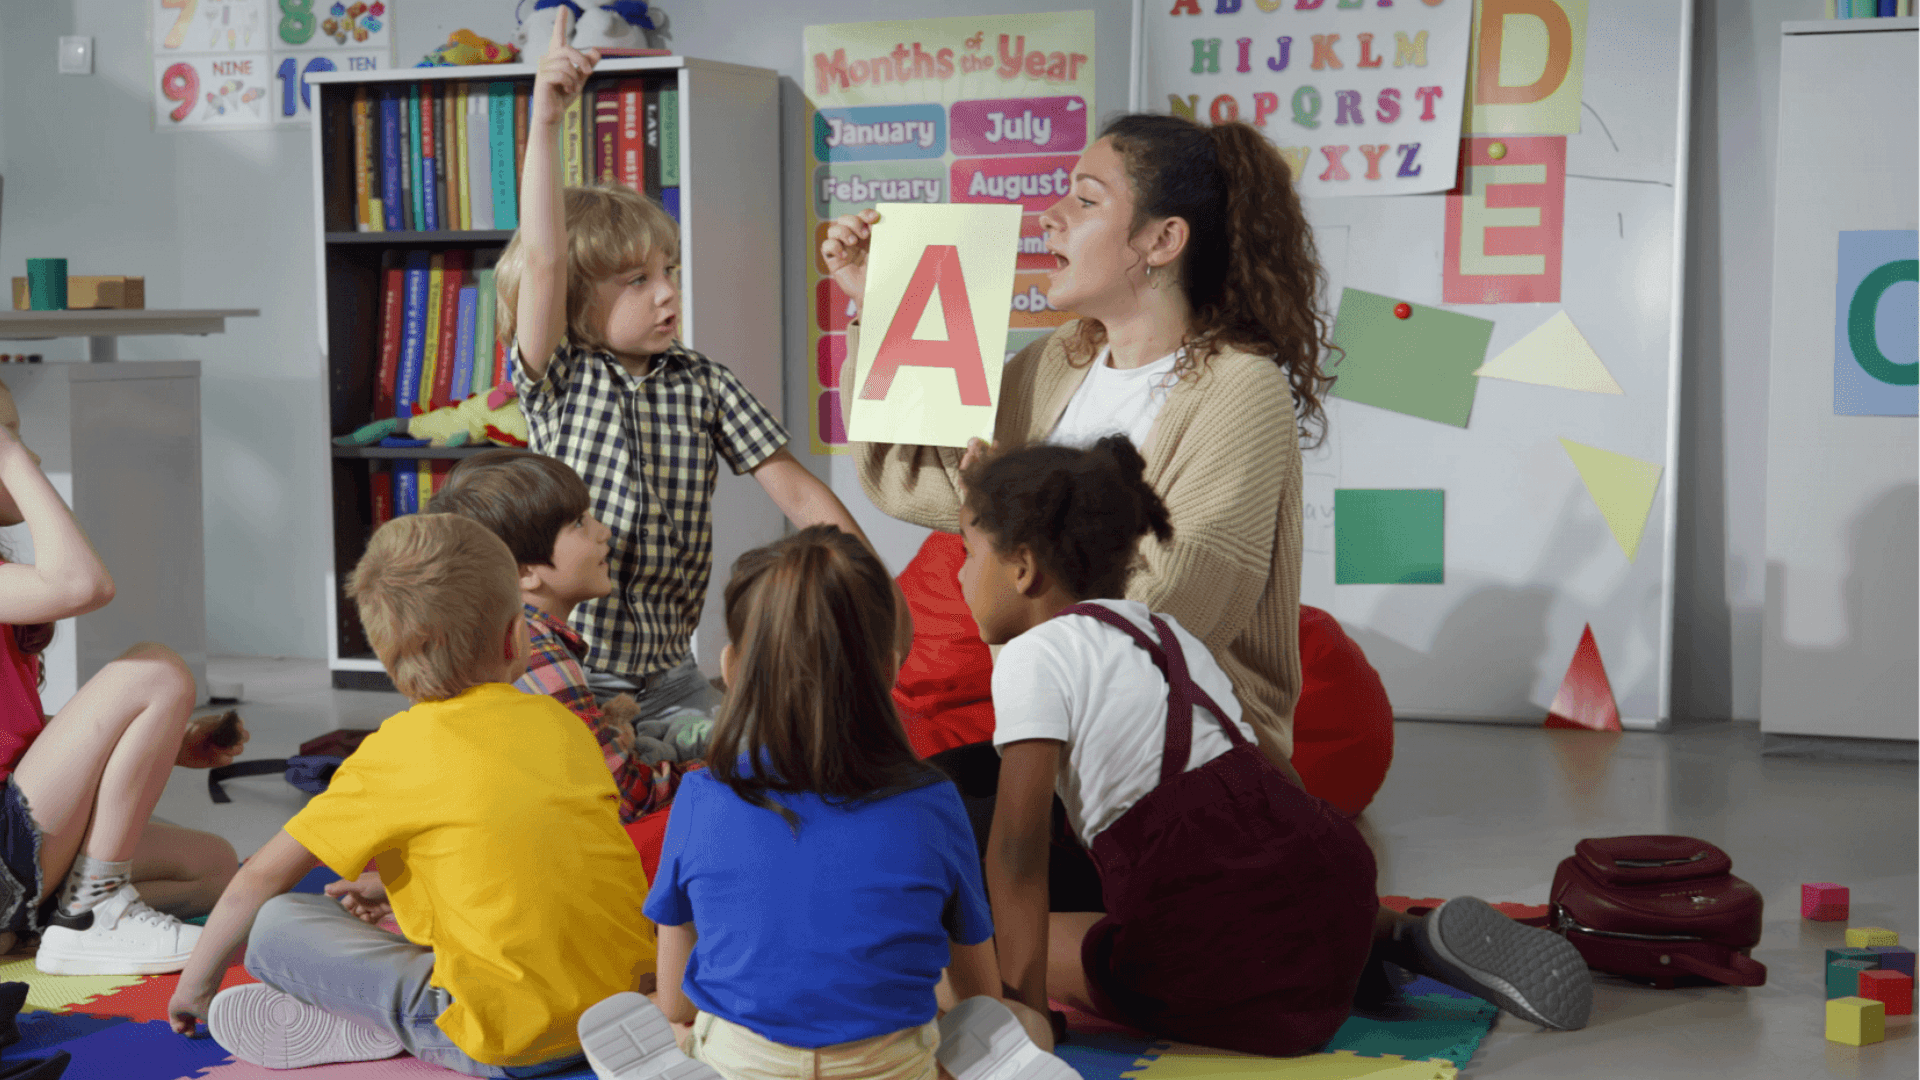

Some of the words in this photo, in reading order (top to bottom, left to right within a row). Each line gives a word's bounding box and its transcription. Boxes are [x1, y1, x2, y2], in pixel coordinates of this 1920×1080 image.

[161, 0, 198, 48] 7
[279, 0, 316, 45] 8
[965, 30, 984, 50] of
[213, 61, 253, 76] NINE
[348, 57, 376, 71] TEN
[813, 42, 955, 95] Months
[960, 51, 994, 75] the
[997, 33, 1088, 82] Year
[1190, 38, 1221, 73] H
[1236, 37, 1252, 73] I
[1267, 36, 1293, 71] J
[1310, 33, 1344, 70] K
[1357, 32, 1383, 68] L
[1393, 30, 1429, 67] M
[1475, 0, 1573, 105] D
[162, 62, 200, 122] 9
[1168, 94, 1199, 122] N
[1209, 94, 1239, 125] O
[1253, 92, 1279, 127] P
[1292, 85, 1322, 128] Q
[1334, 89, 1365, 125] R
[1376, 87, 1402, 124] S
[1415, 85, 1443, 122] T
[625, 92, 638, 140] WORLD
[647, 104, 658, 147] LAW
[826, 118, 936, 148] January
[985, 110, 1052, 146] July
[1319, 144, 1351, 181] X
[1359, 143, 1391, 180] Y
[1396, 142, 1421, 178] Z
[823, 175, 941, 204] February
[968, 168, 1070, 200] August
[1459, 164, 1547, 275] E
[858, 245, 992, 407] A
[1848, 259, 1919, 385] C
